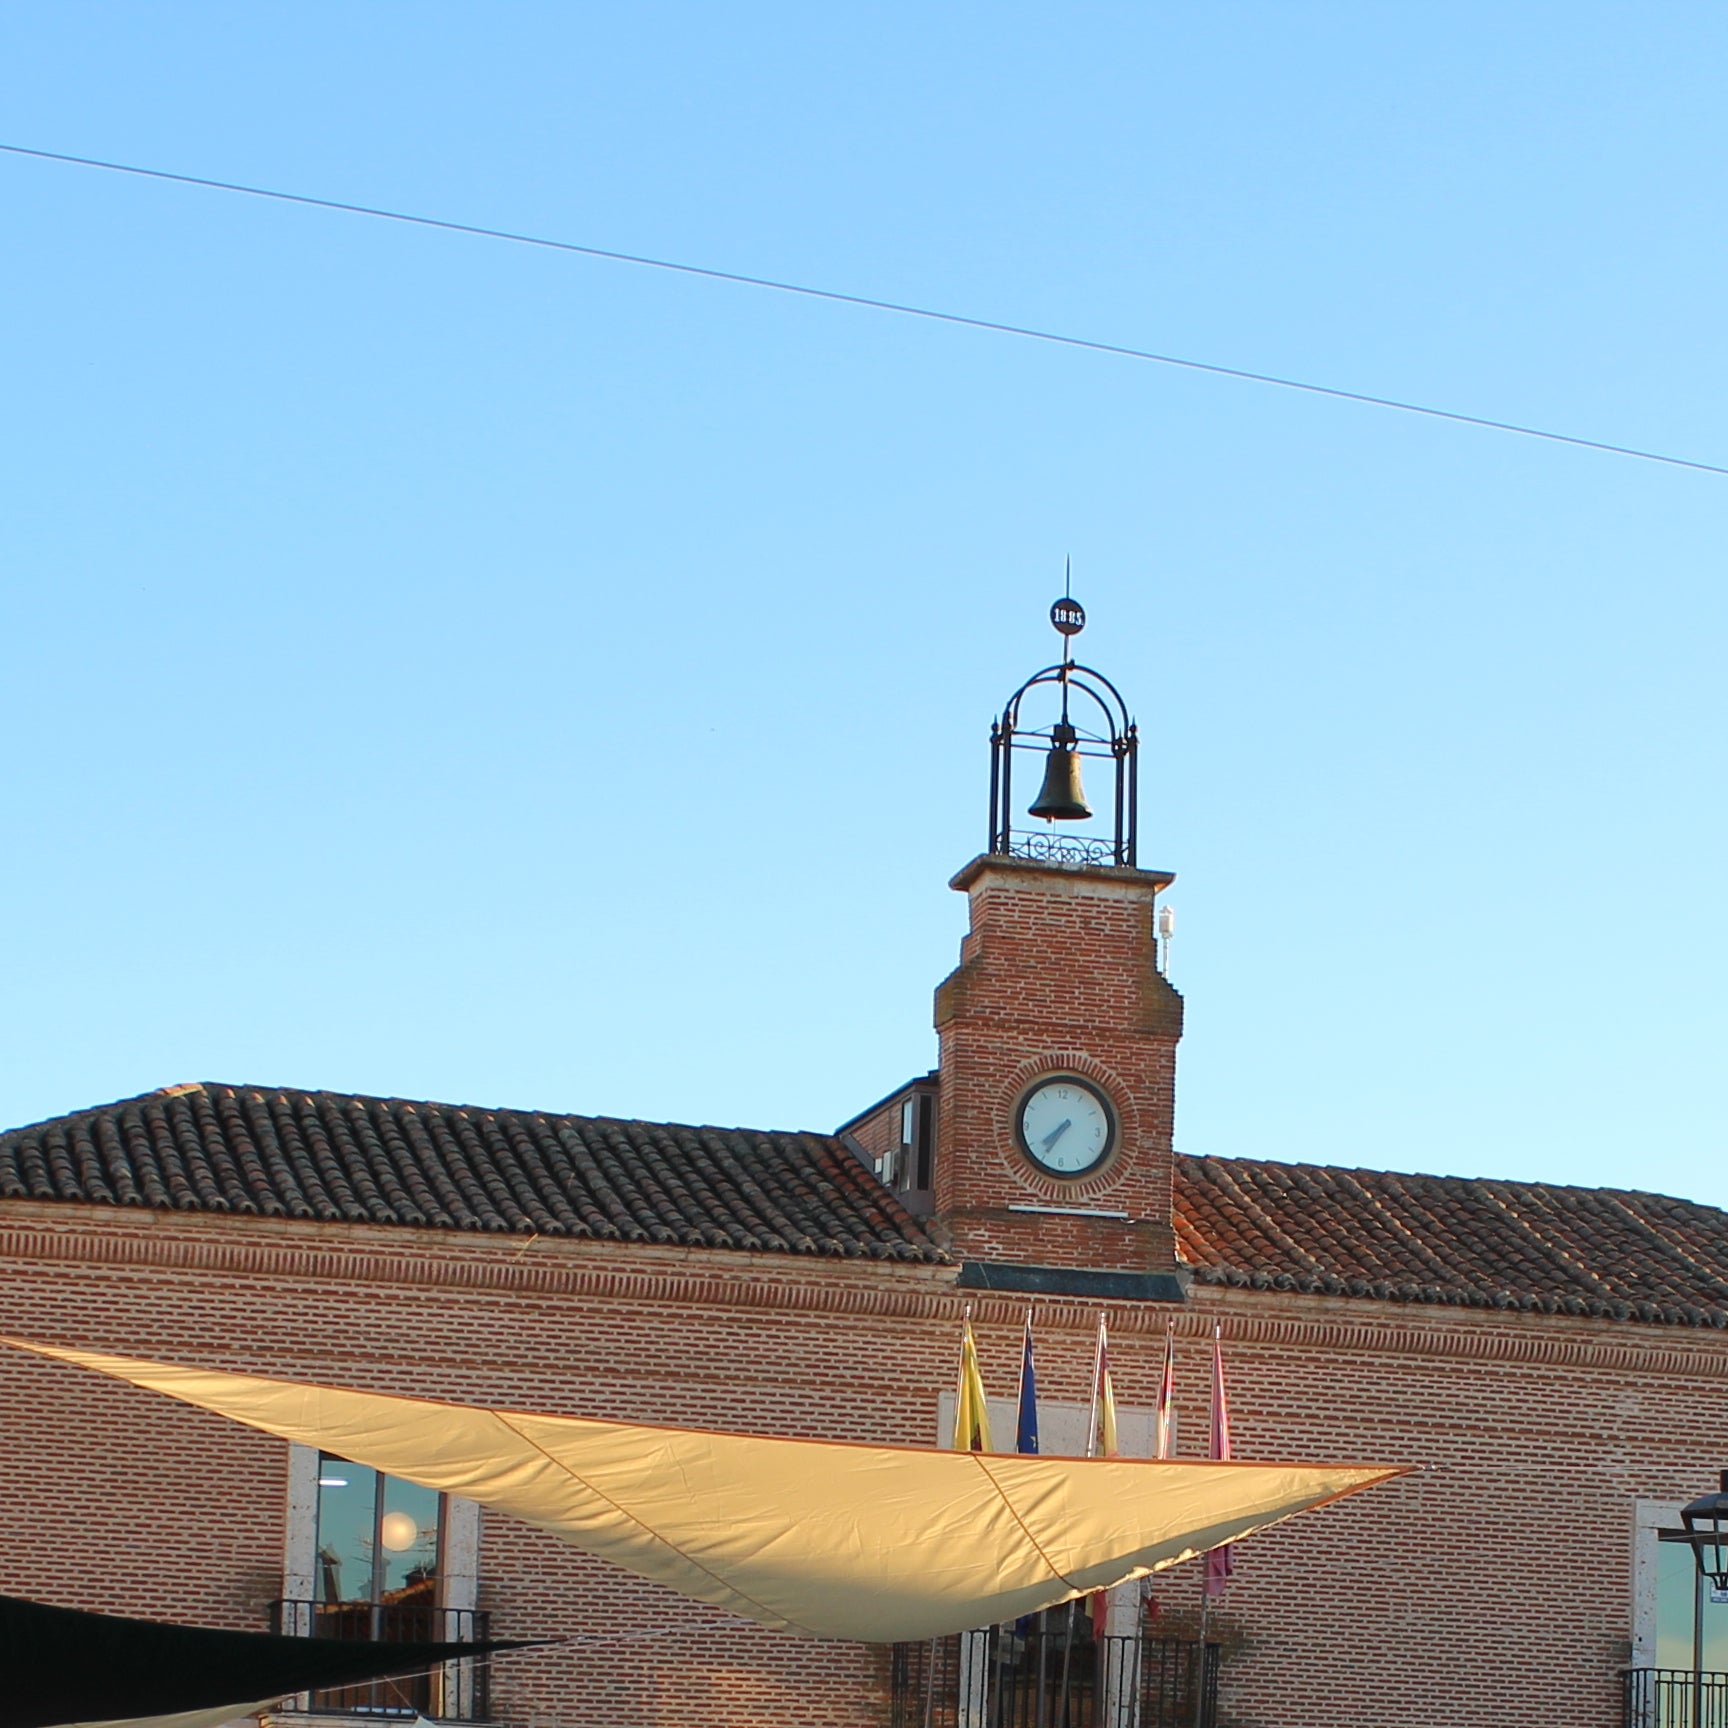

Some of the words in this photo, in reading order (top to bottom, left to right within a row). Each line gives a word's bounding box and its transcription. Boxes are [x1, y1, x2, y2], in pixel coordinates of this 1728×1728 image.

[1057, 1089, 1069, 1100] 12
[1094, 1127, 1102, 1138] 3
[1057, 1157, 1065, 1168] 6
